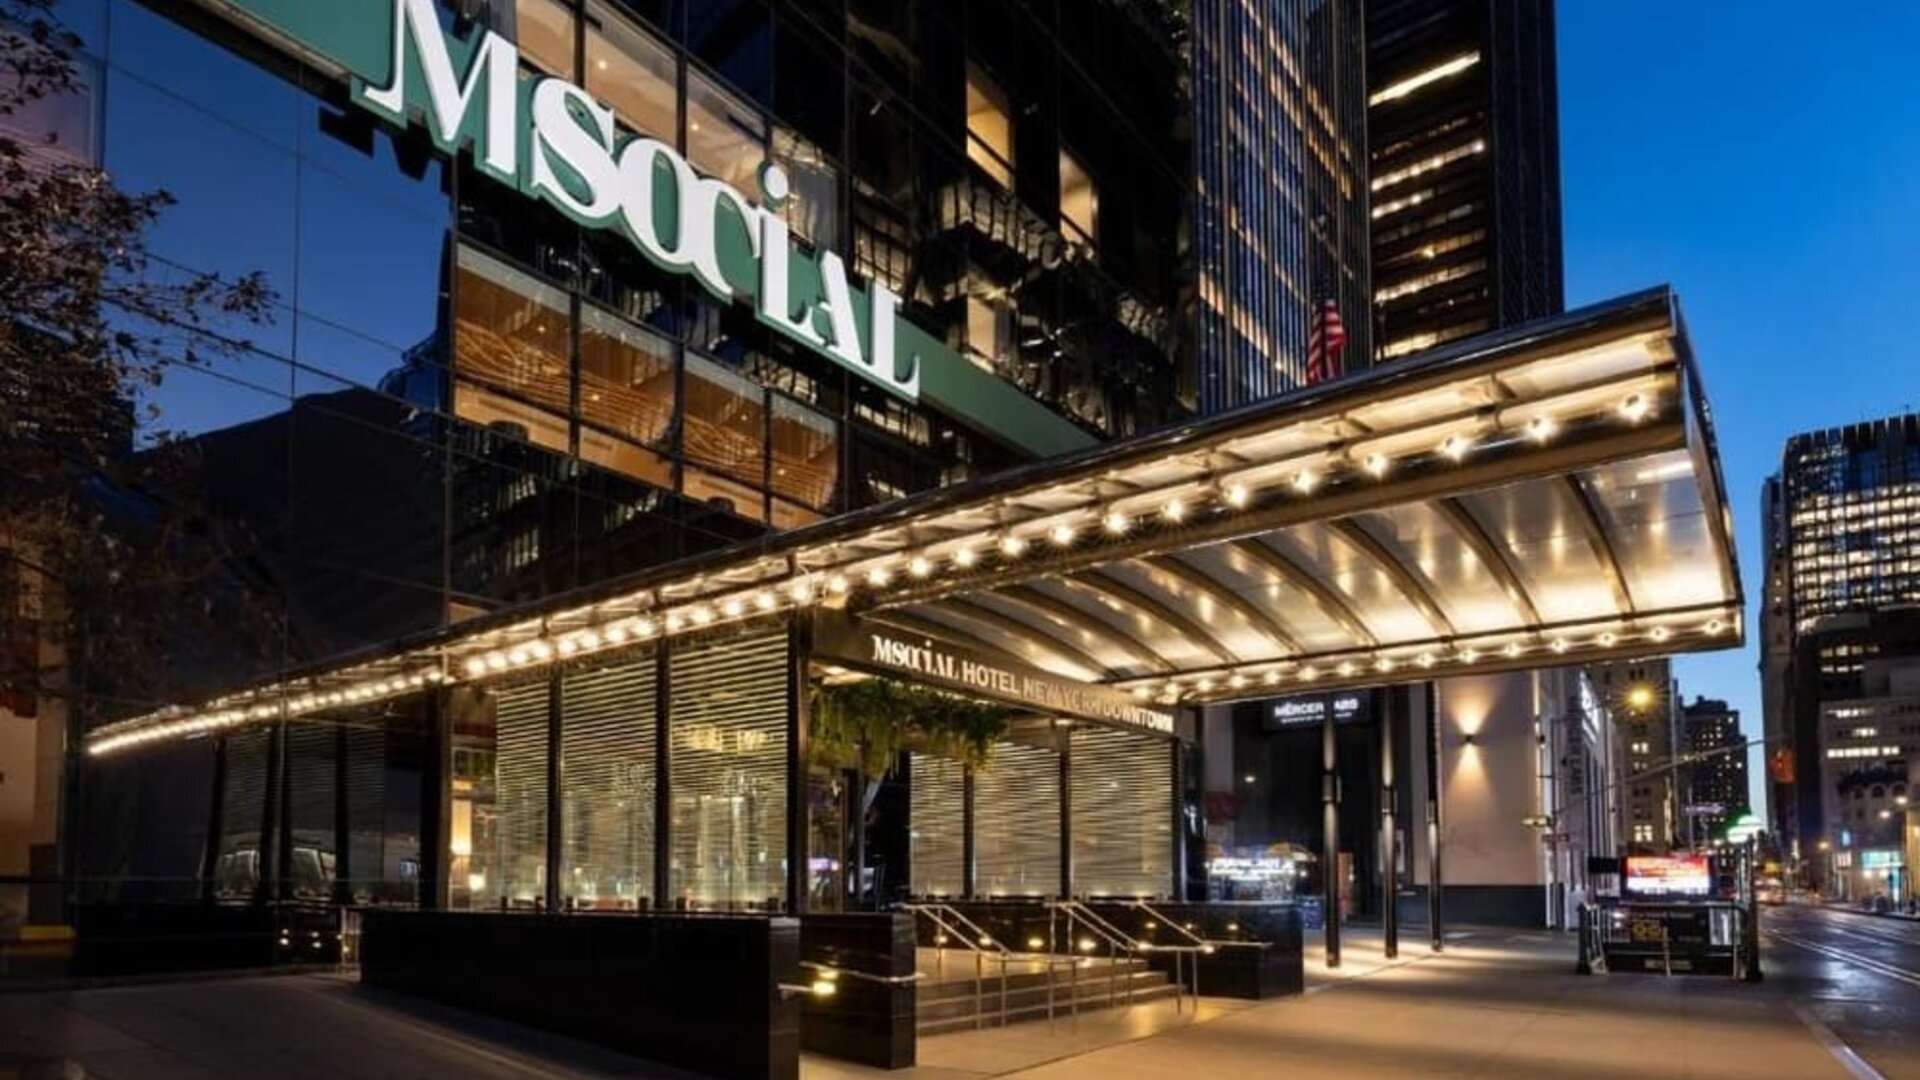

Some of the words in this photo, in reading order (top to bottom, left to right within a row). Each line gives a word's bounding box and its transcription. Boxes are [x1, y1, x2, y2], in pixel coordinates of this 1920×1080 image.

[962, 660, 1020, 694] HOTEL
[1022, 676, 1063, 708] NEW
[1103, 698, 1175, 733] DOWNTOWN
